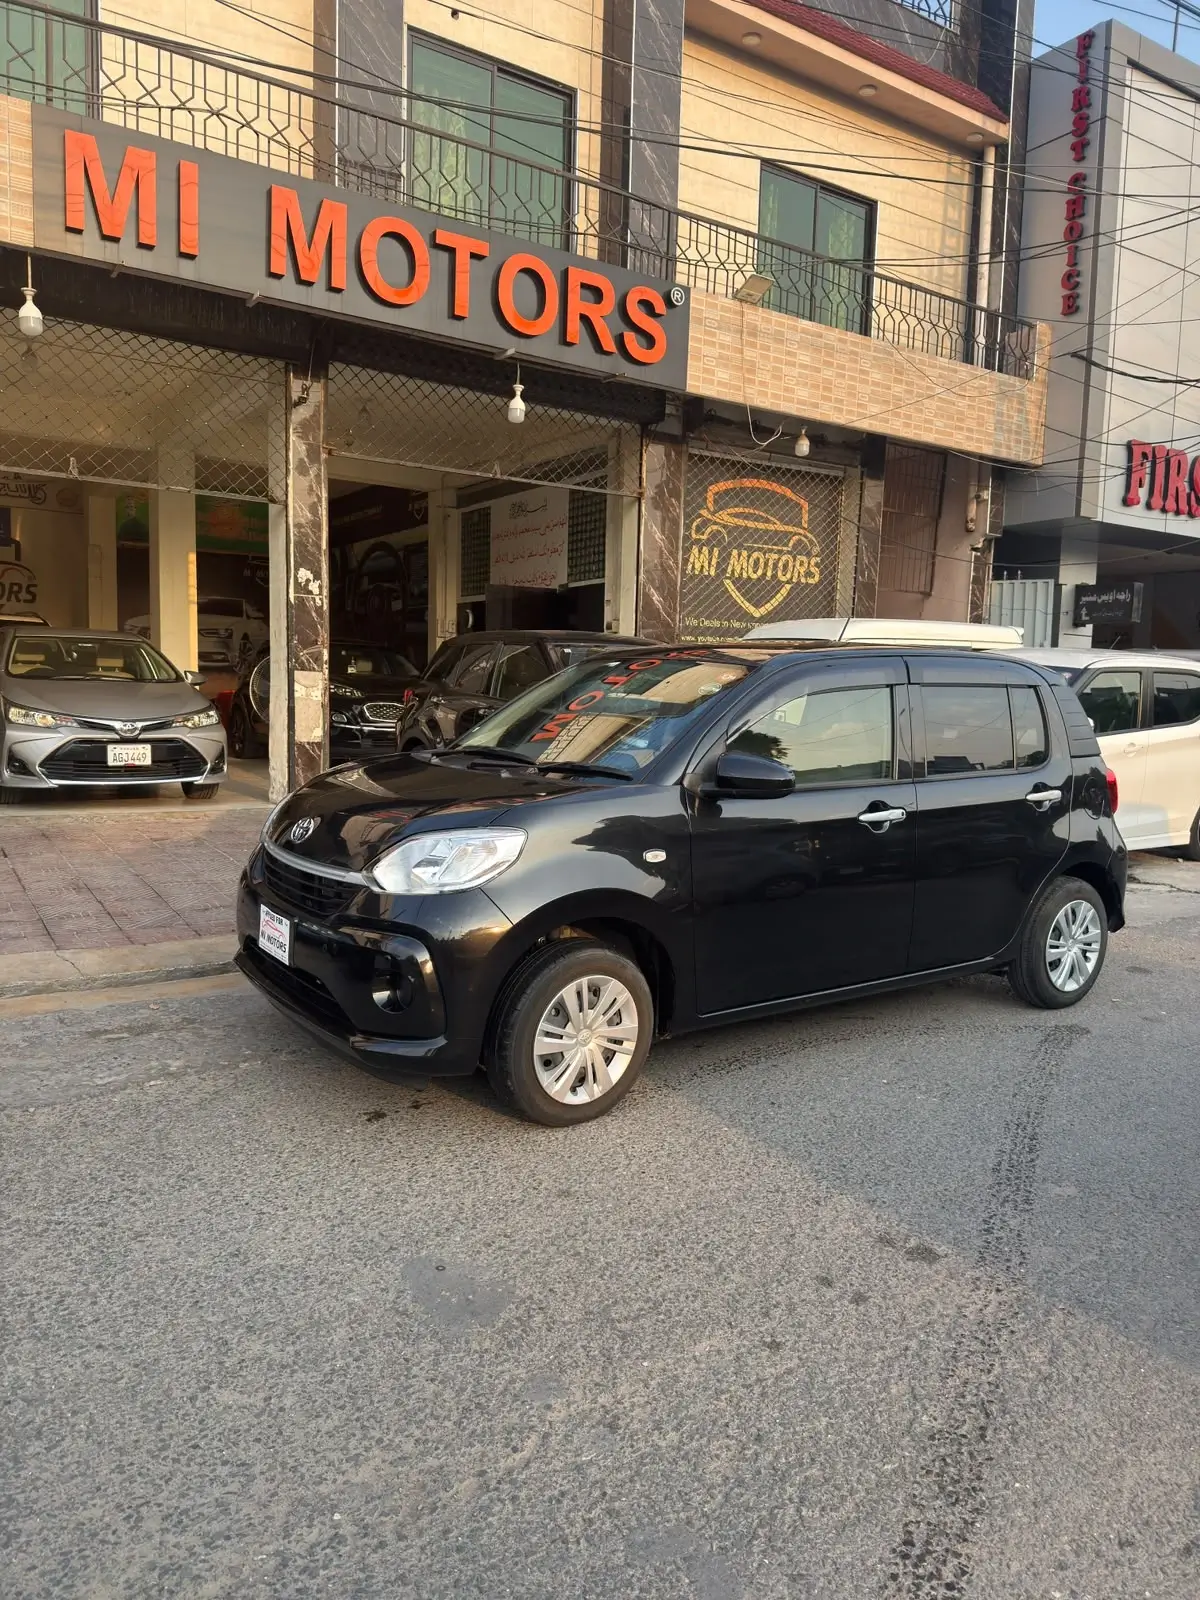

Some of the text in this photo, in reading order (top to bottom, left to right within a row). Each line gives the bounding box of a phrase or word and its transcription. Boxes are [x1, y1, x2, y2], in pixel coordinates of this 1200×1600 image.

[1060, 29, 1096, 316] FIRST CHOICE
[64, 128, 199, 260] MI
[270, 183, 667, 366] MOTORS
[685, 544, 822, 584] MI MOTORS
[267, 934, 287, 953] MOTORS
